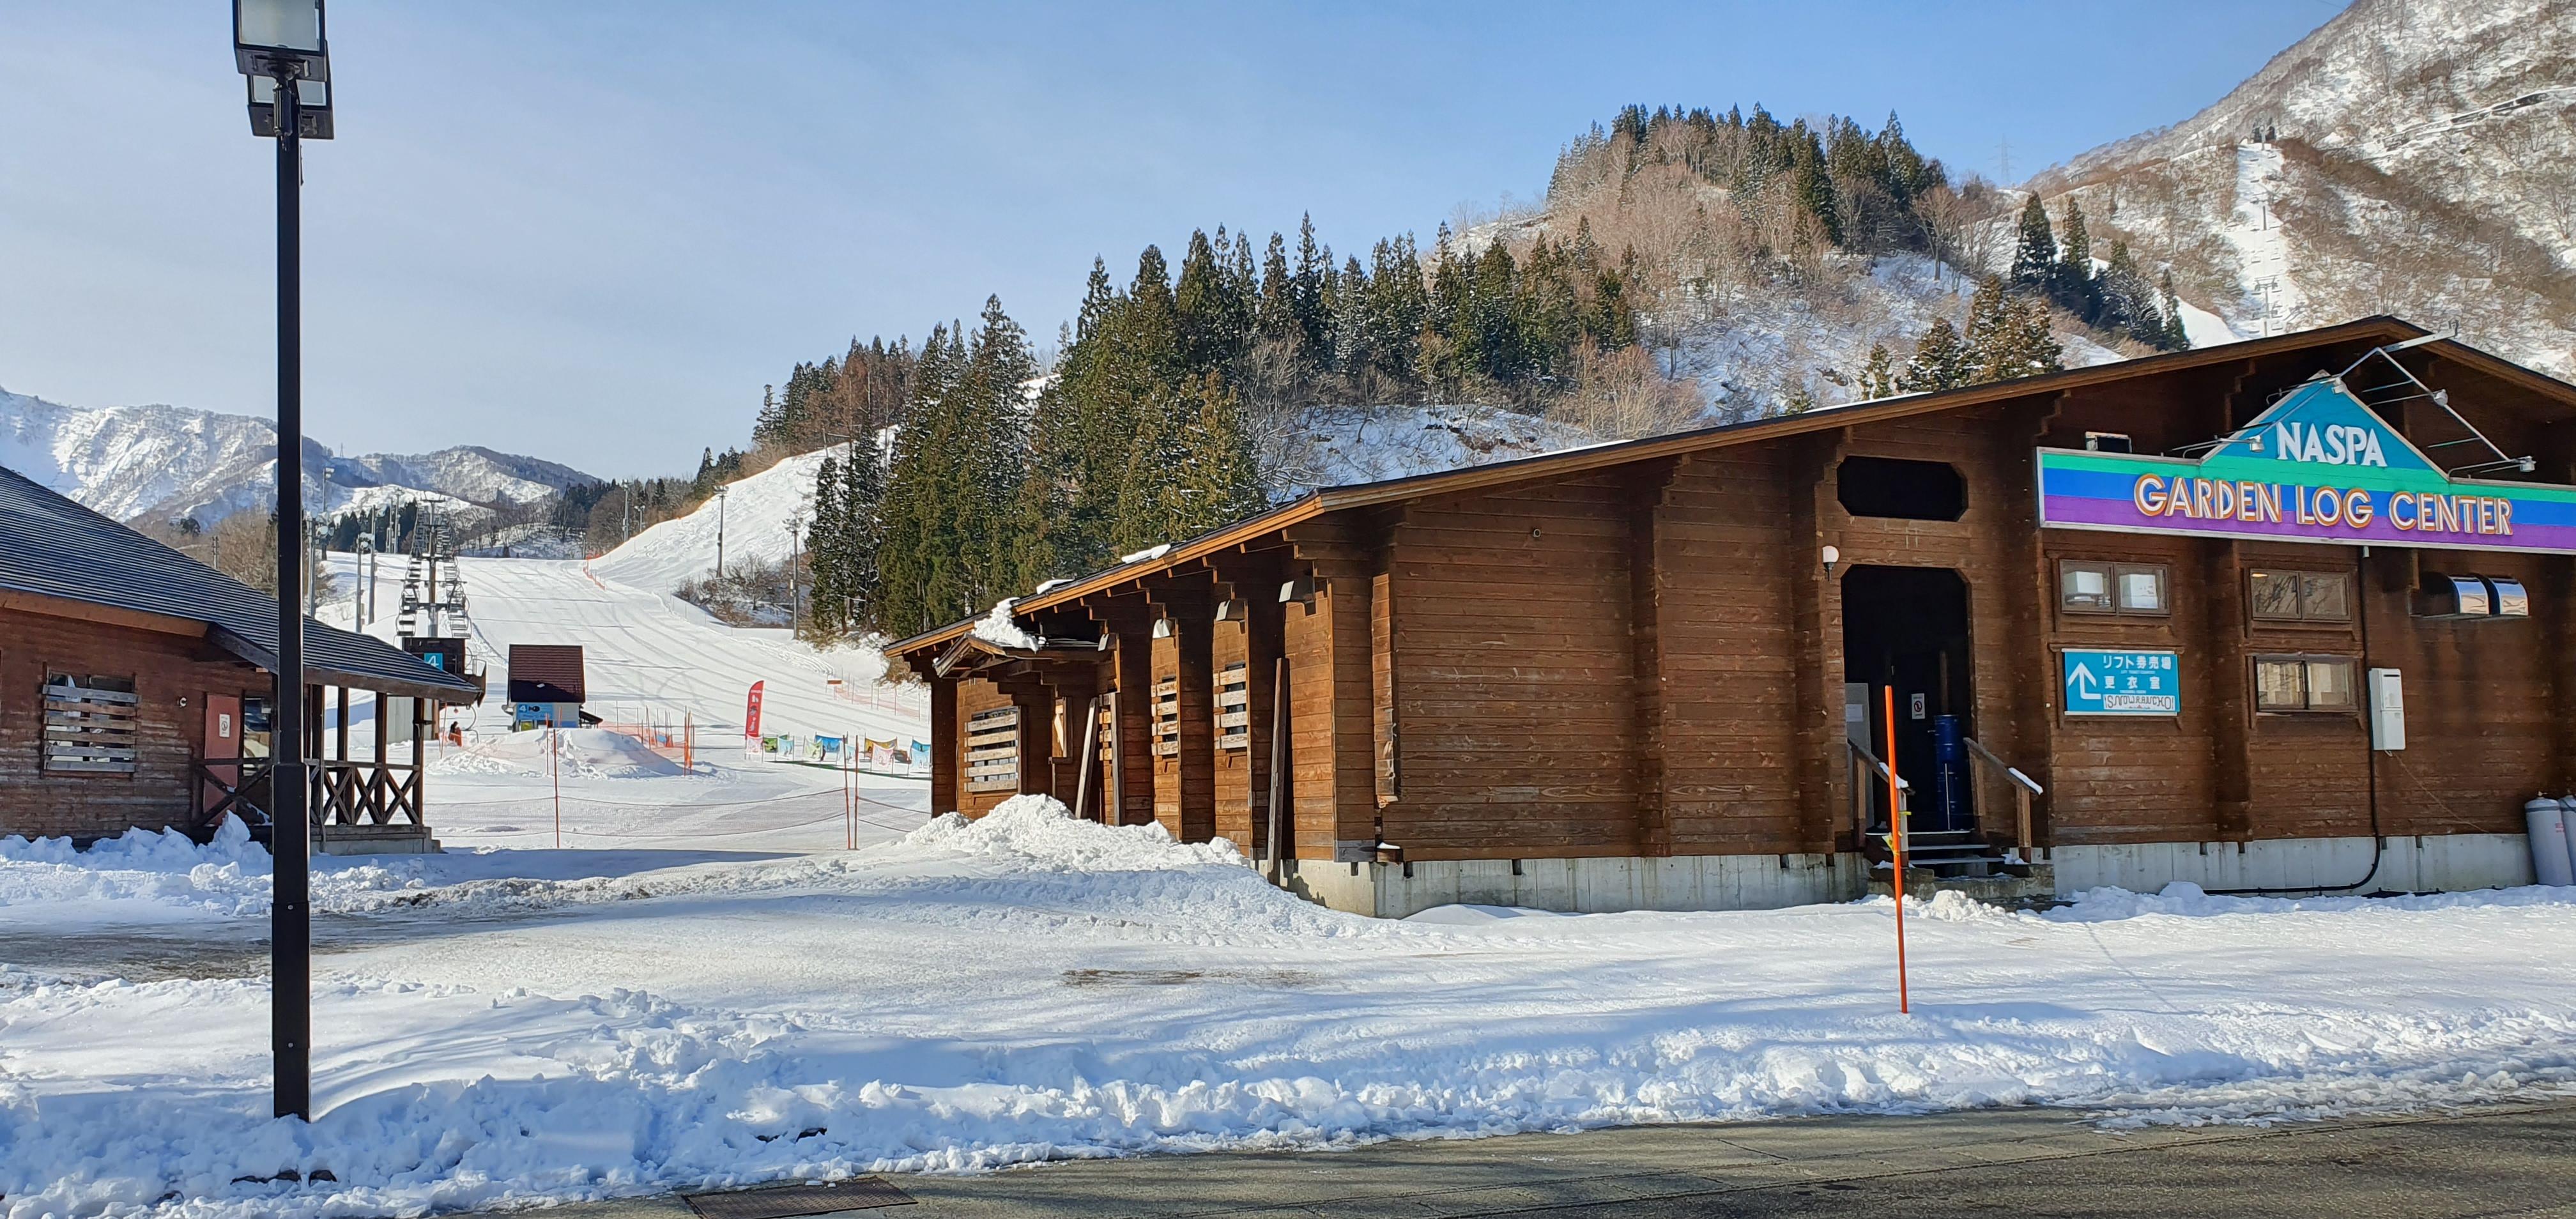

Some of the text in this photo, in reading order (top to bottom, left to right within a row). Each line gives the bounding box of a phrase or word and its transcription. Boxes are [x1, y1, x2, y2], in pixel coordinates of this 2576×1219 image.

[2276, 422, 2388, 468] NASPA
[2134, 473, 2513, 536] GARDEN LOG CENTER
[428, 656, 440, 667] 4
